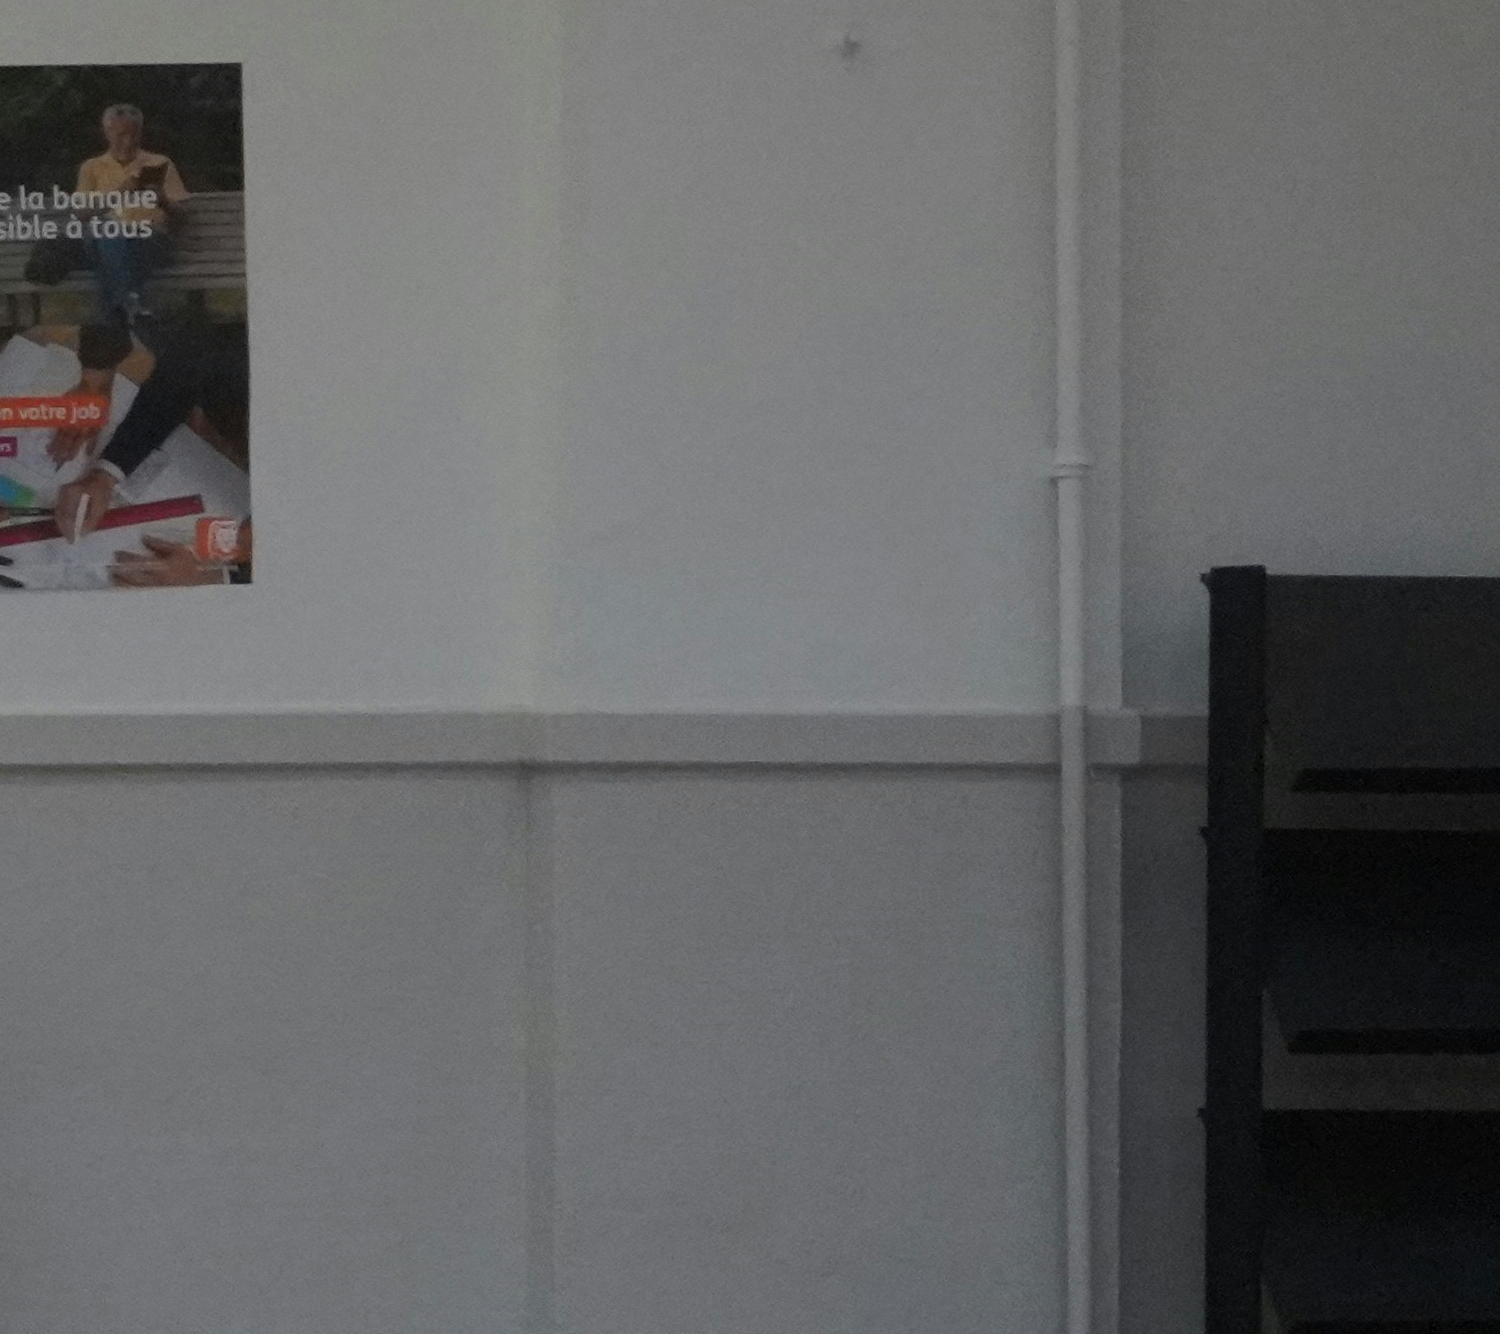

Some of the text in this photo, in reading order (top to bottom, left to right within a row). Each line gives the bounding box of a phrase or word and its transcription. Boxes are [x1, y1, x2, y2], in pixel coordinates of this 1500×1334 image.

[19, 185, 45, 210] la
[53, 185, 157, 217] banque
[66, 214, 83, 239] à
[89, 217, 153, 239] tous
[19, 405, 66, 421] votre
[70, 403, 101, 424] job
